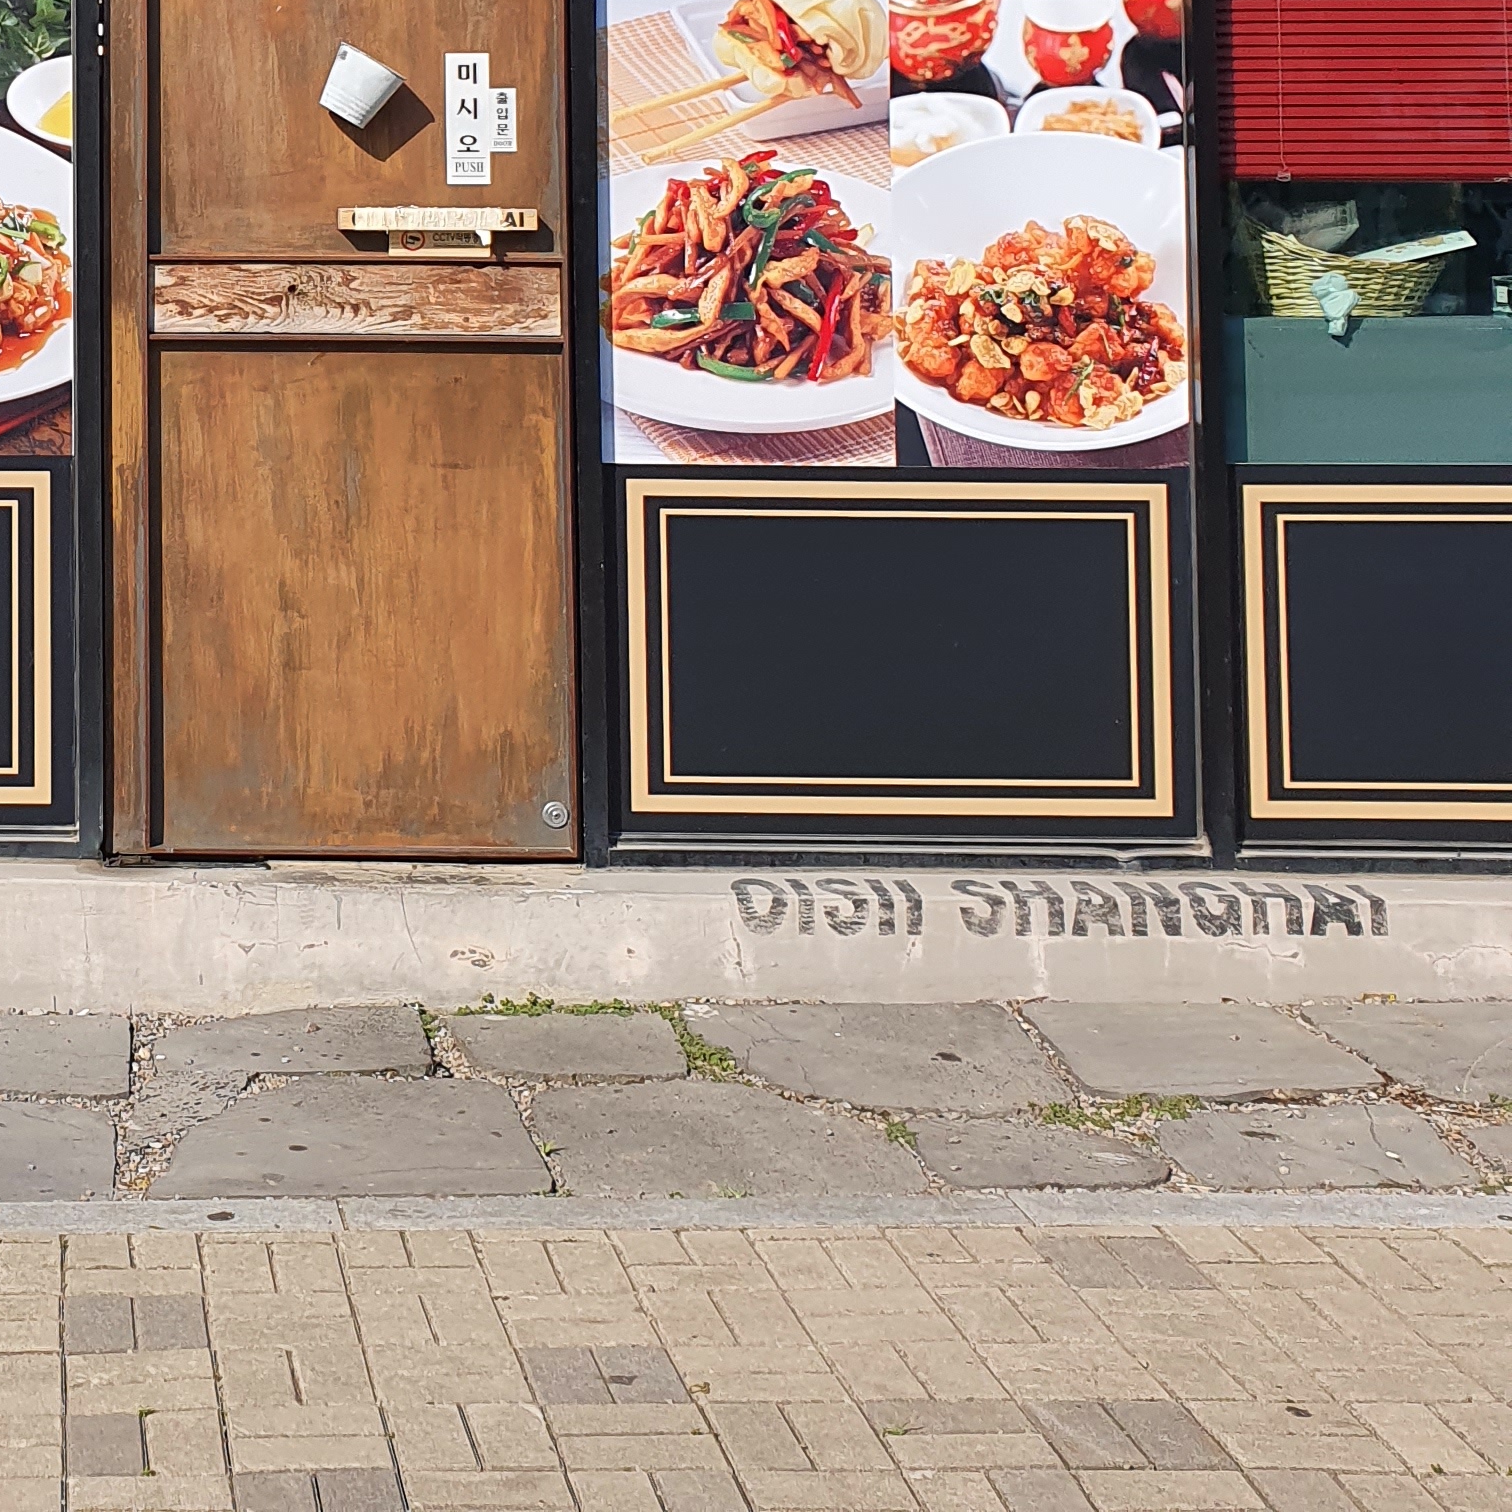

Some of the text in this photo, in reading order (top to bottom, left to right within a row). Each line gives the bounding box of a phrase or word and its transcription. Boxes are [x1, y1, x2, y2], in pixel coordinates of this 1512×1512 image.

[457, 62, 480, 153] 미시오
[496, 92, 510, 136] 출입문
[732, 877, 1390, 938] OISII SHANGHAI
